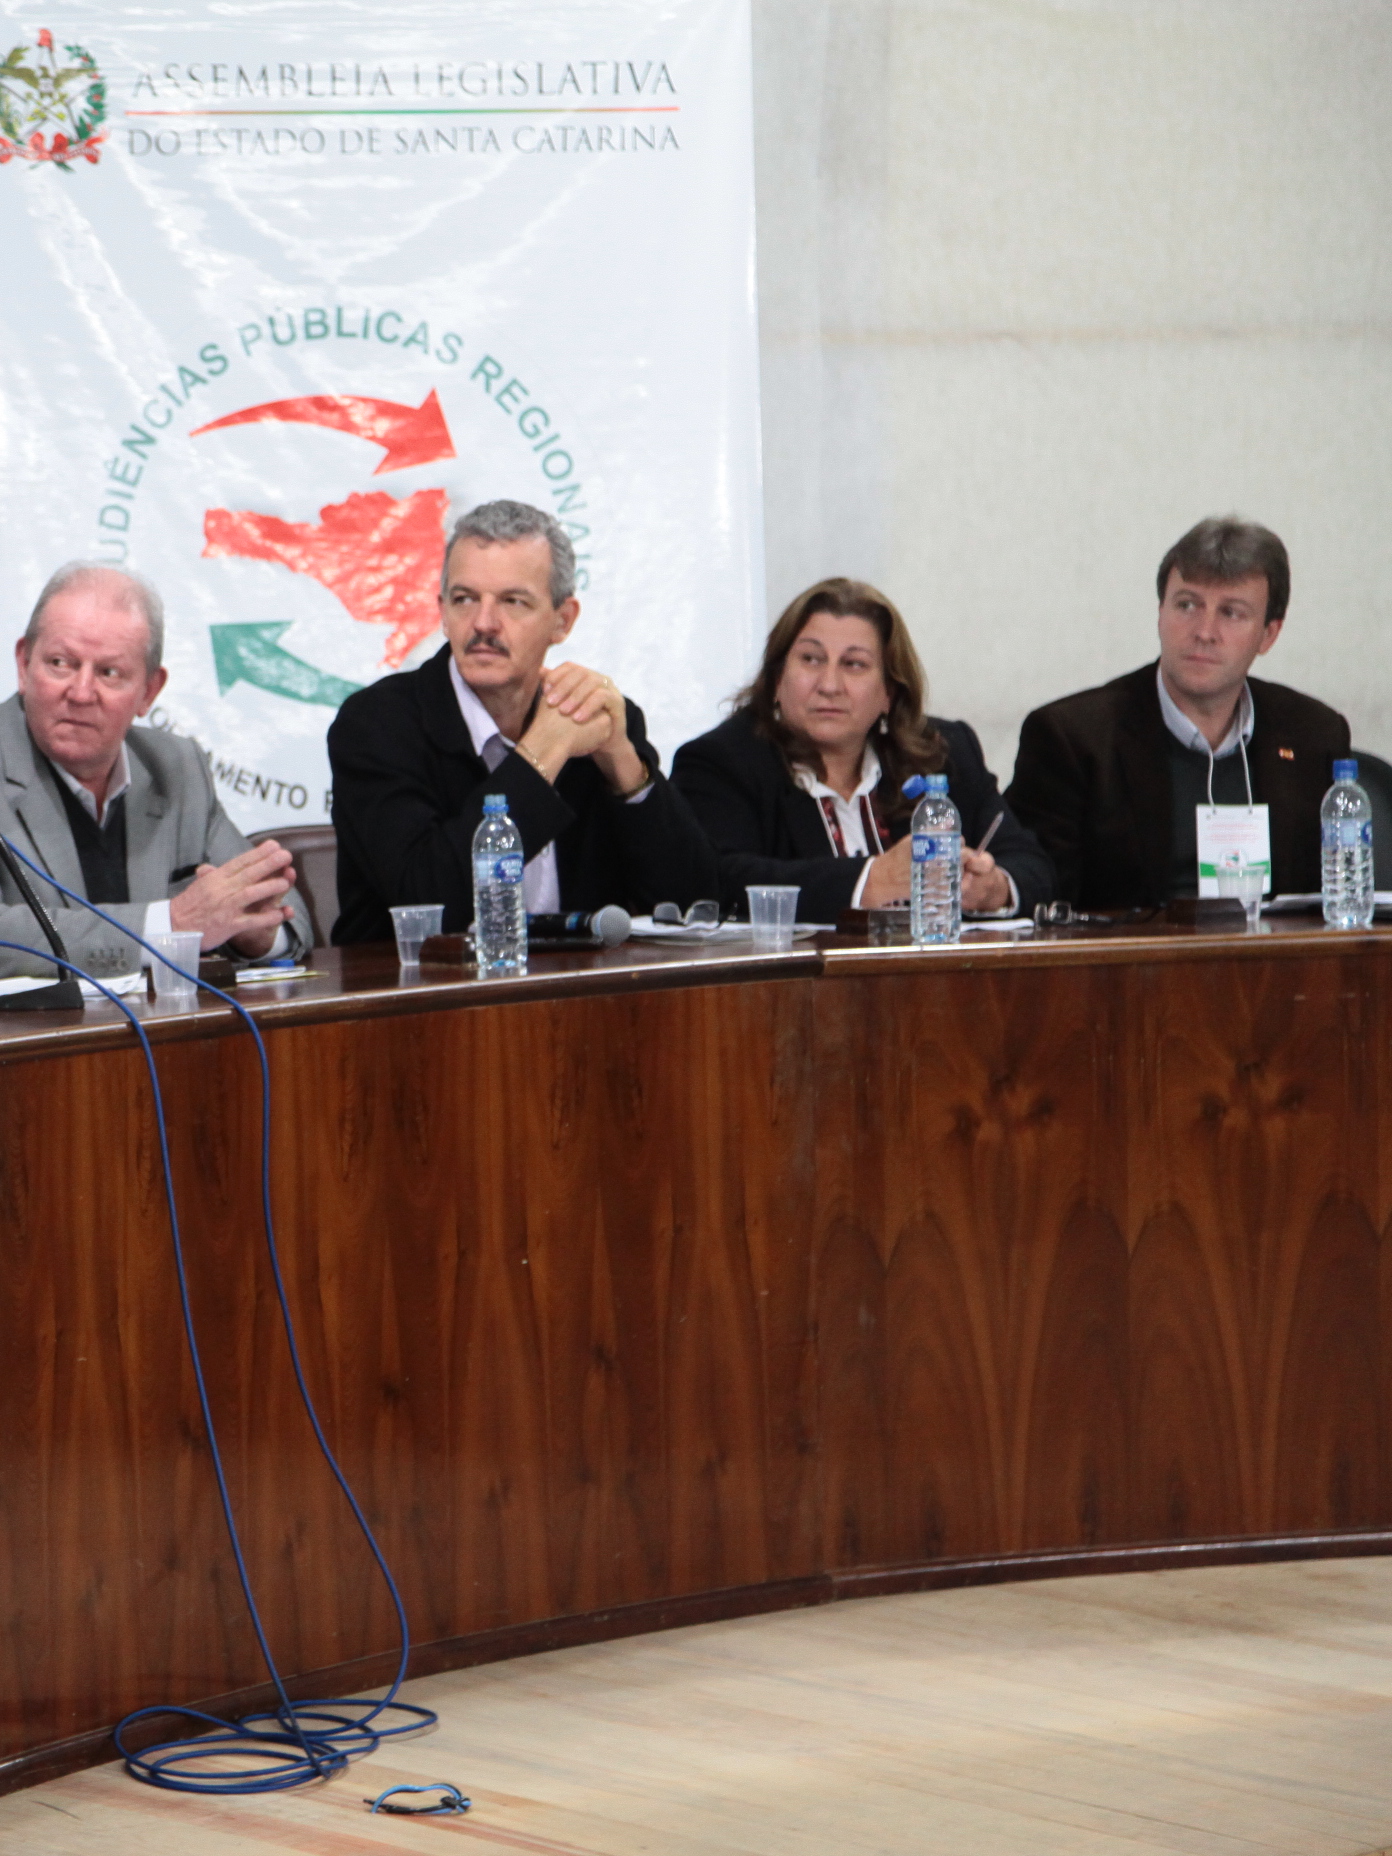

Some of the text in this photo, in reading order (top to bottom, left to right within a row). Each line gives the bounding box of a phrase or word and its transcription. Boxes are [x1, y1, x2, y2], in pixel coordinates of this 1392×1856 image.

[132, 60, 678, 98] ASSEMBLEIA LEGISLATIVA
[127, 127, 181, 156] DO
[195, 127, 326, 156] ESTADO
[339, 126, 382, 155] DE
[394, 125, 501, 154] SANTA
[511, 123, 680, 154] CATARINA
[98, 305, 592, 592] UDIÊNCIAS PÚBLICAS REGIONAIS
